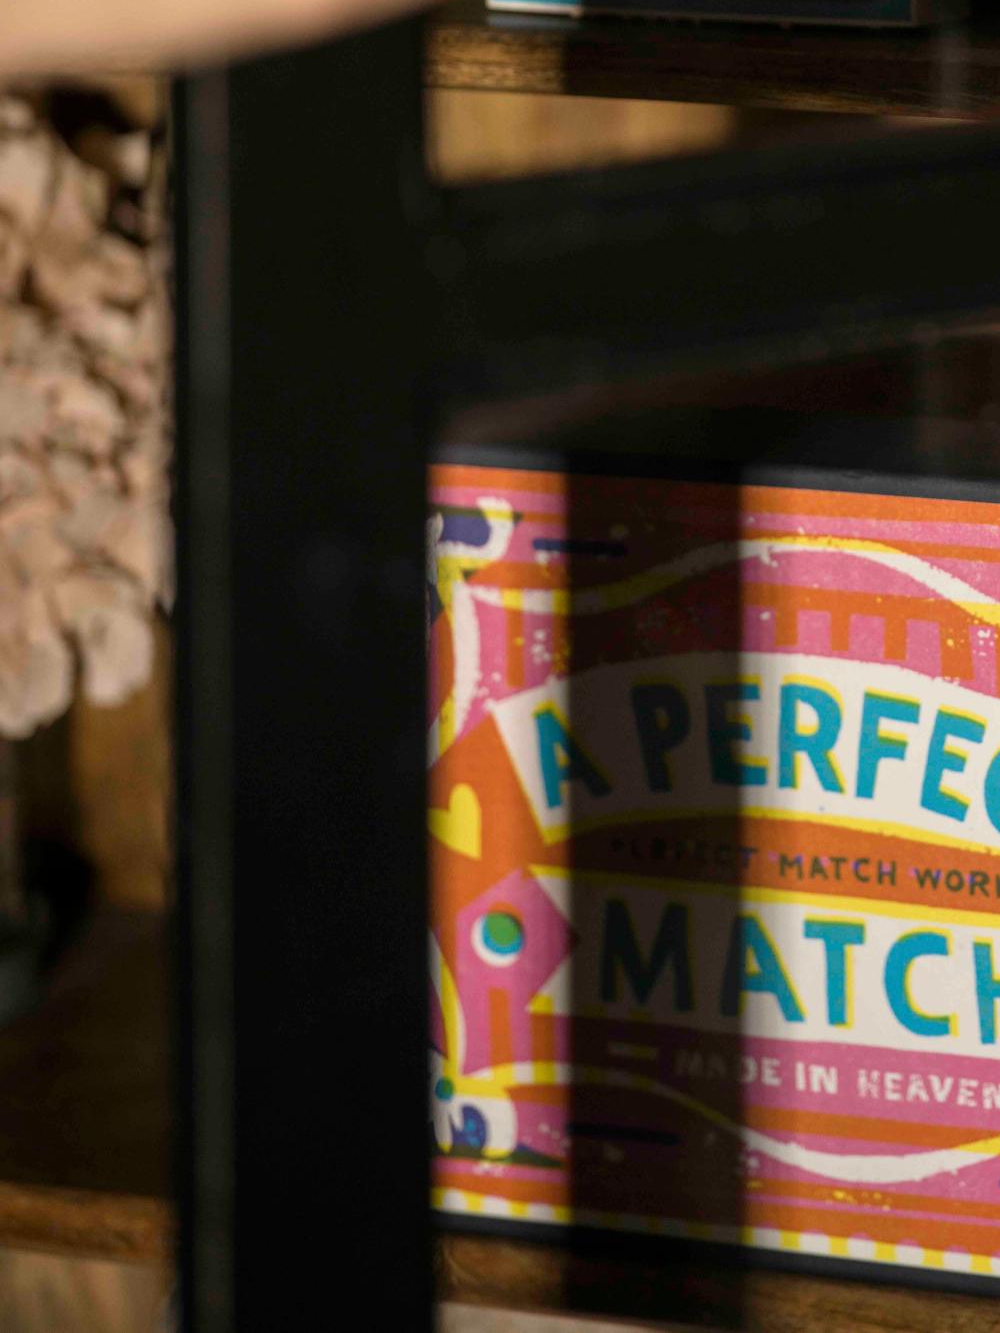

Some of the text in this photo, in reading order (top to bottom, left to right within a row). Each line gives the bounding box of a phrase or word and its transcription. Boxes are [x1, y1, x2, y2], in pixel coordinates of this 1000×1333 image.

[536, 704, 614, 808] A
[778, 852, 897, 887] MATCH
[675, 1048, 782, 1087] MADE
[795, 1060, 838, 1095] IN
